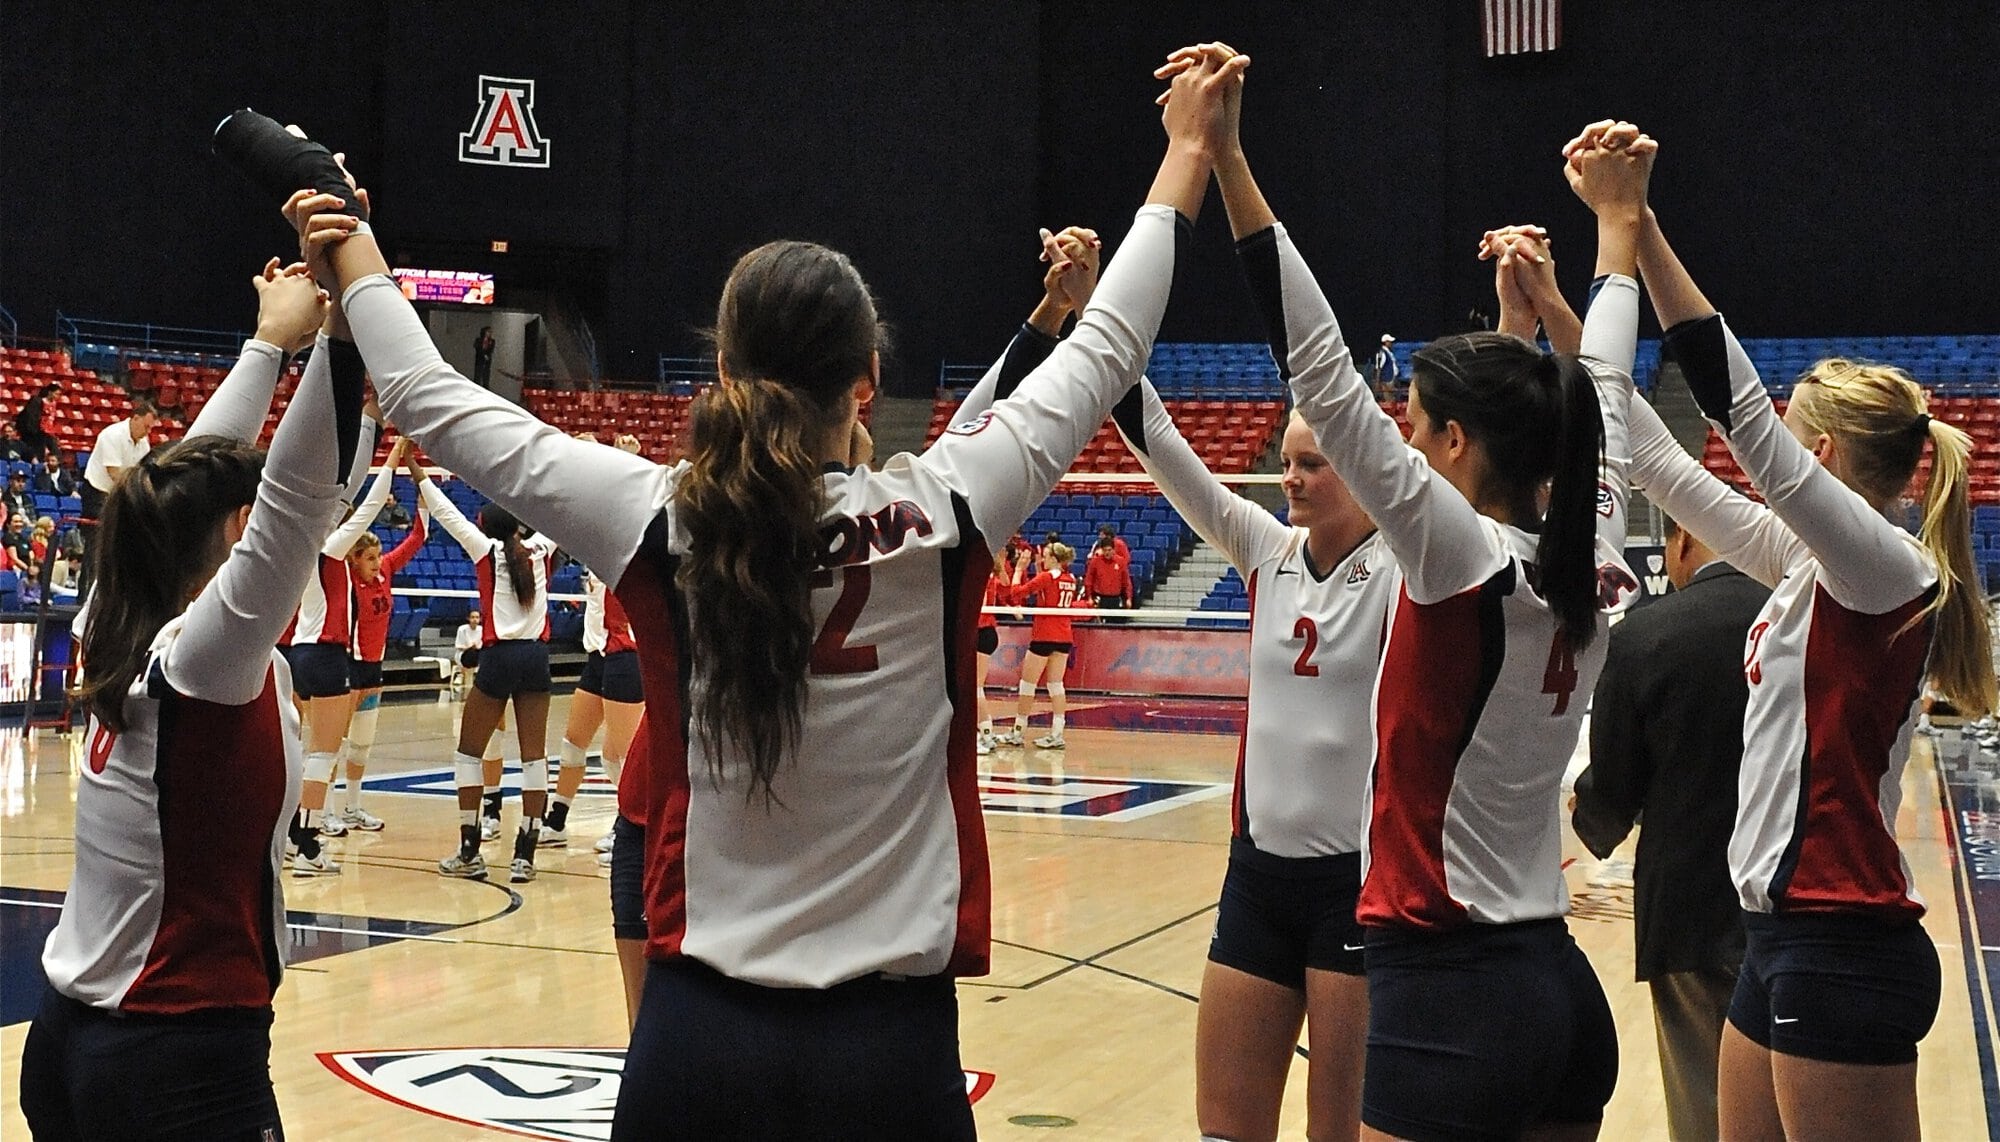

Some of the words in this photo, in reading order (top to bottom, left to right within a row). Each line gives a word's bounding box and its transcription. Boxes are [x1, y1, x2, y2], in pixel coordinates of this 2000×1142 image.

[459, 75, 550, 168] A
[1057, 590, 1073, 608] 10
[1107, 645, 1250, 677] ARIZON
[1293, 617, 1319, 677] 2
